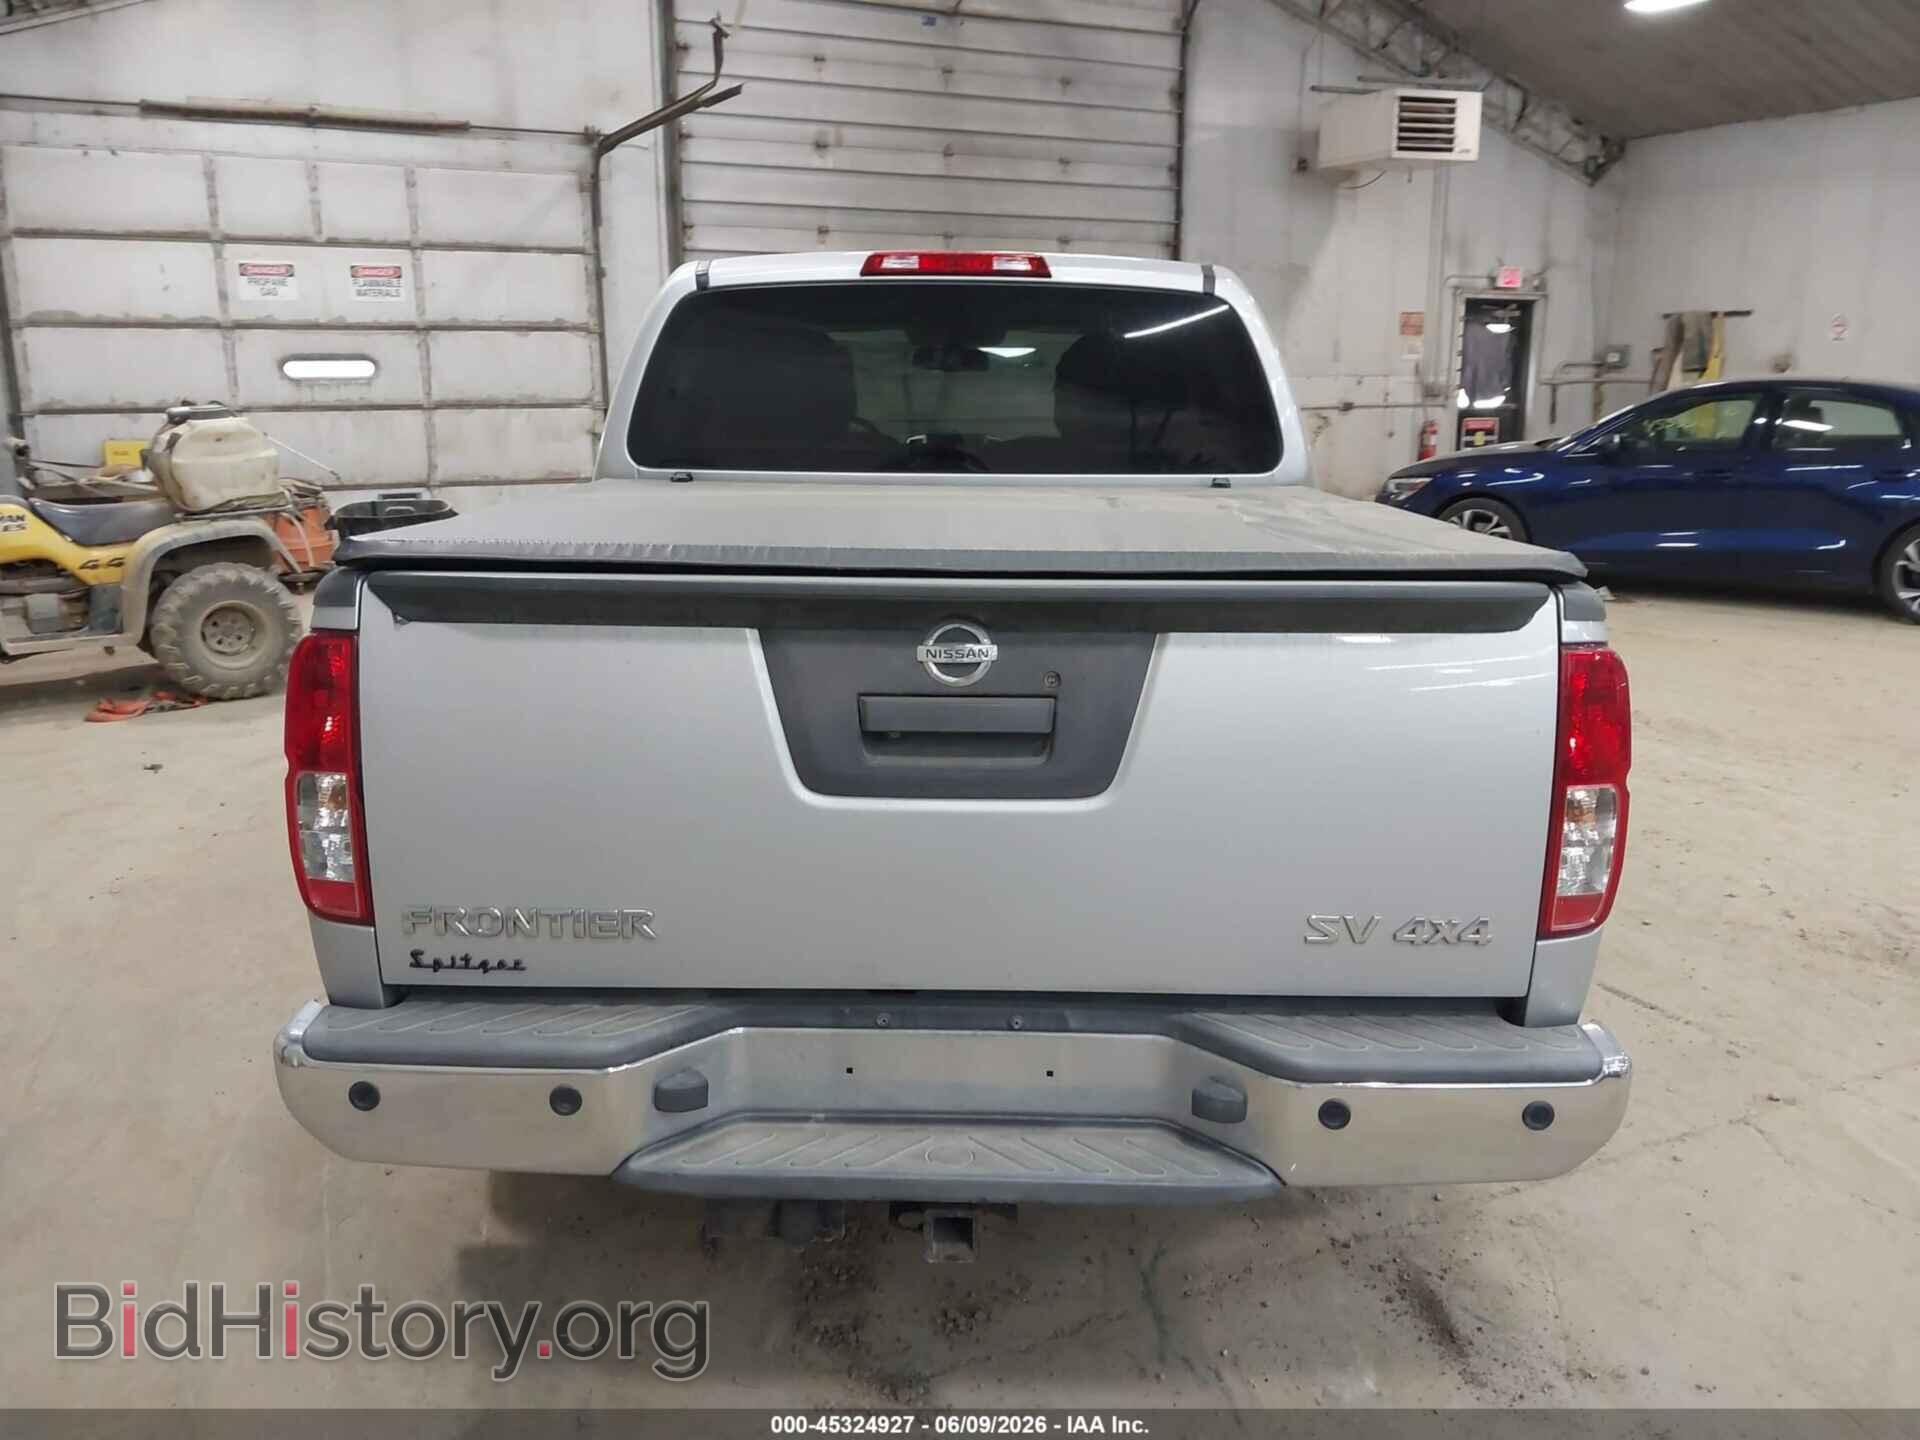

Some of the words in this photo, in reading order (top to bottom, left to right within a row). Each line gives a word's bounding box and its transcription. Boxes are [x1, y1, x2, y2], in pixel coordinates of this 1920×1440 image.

[925, 647, 989, 661] NISSAN
[403, 906, 656, 939] FRONTIER
[1304, 915, 1383, 945] SV
[1392, 915, 1493, 945] 4x4
